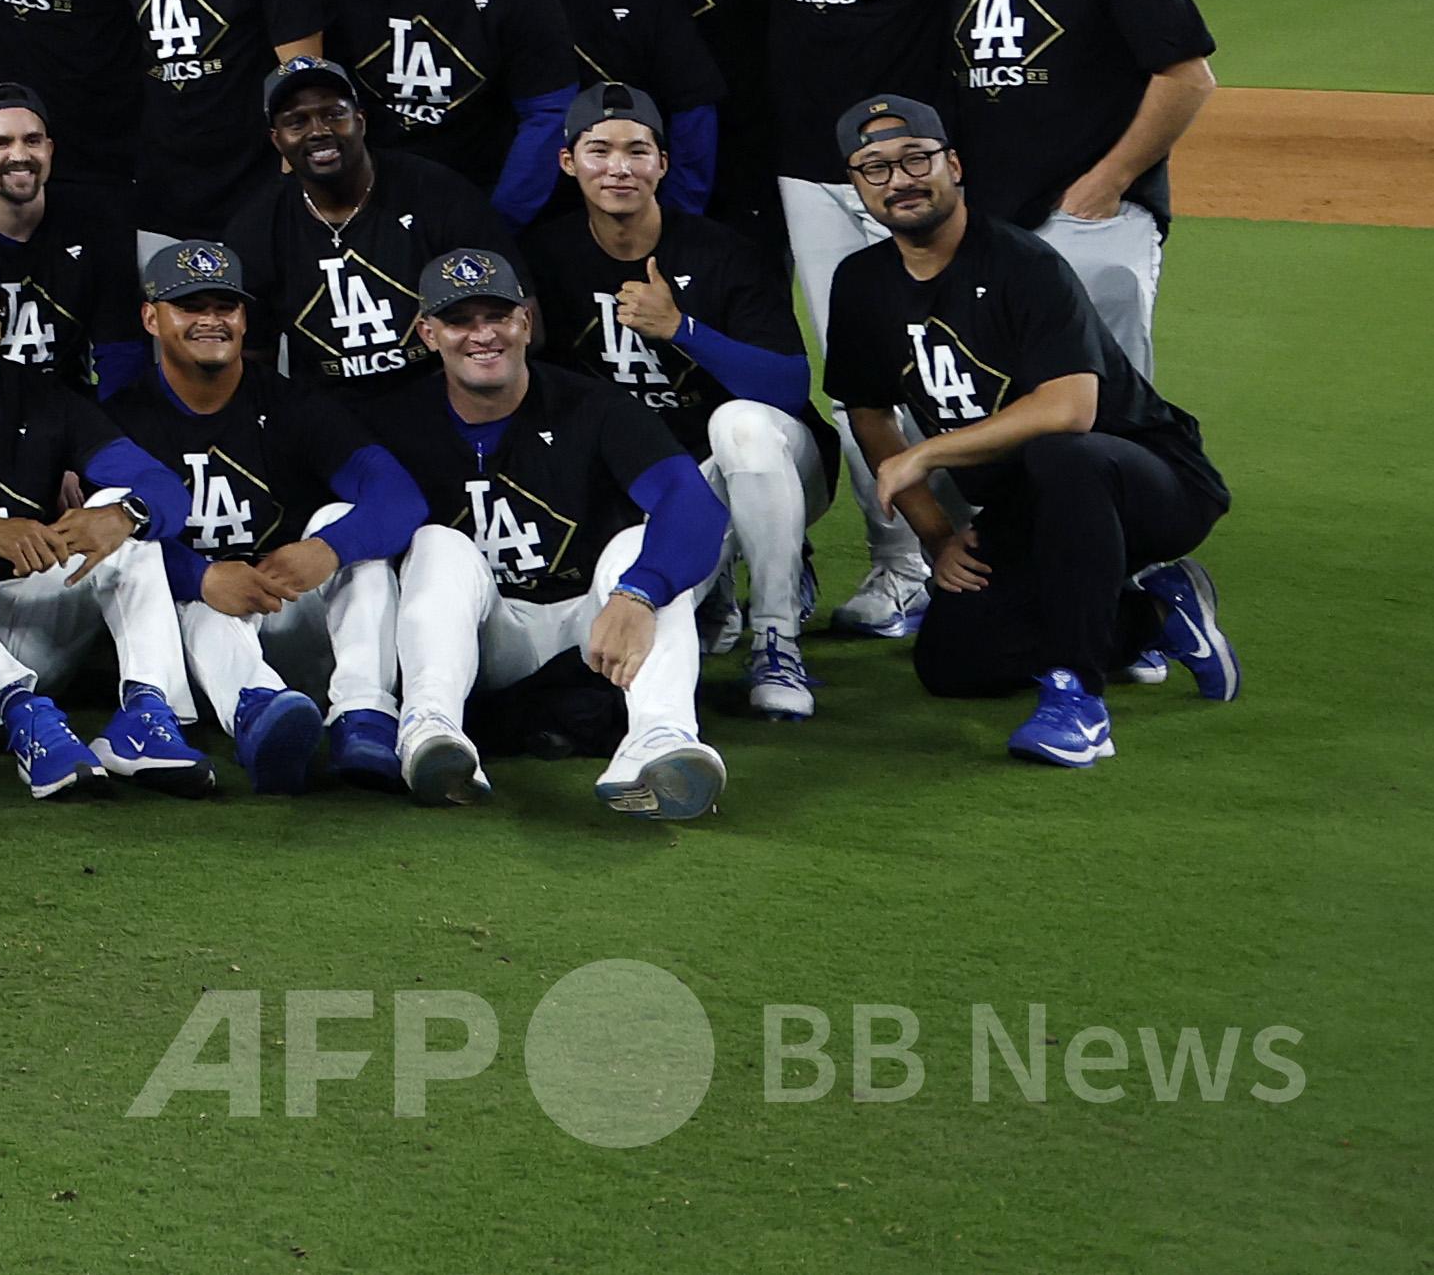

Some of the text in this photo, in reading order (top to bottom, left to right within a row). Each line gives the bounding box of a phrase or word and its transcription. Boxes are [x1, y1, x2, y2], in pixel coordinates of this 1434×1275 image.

[387, 16, 451, 103] LA
[970, 66, 1023, 87] NLCS
[318, 257, 398, 348] LA
[341, 349, 405, 377] NLCS
[907, 323, 989, 418] LA
[183, 452, 254, 548] LA
[464, 480, 549, 574] LA
